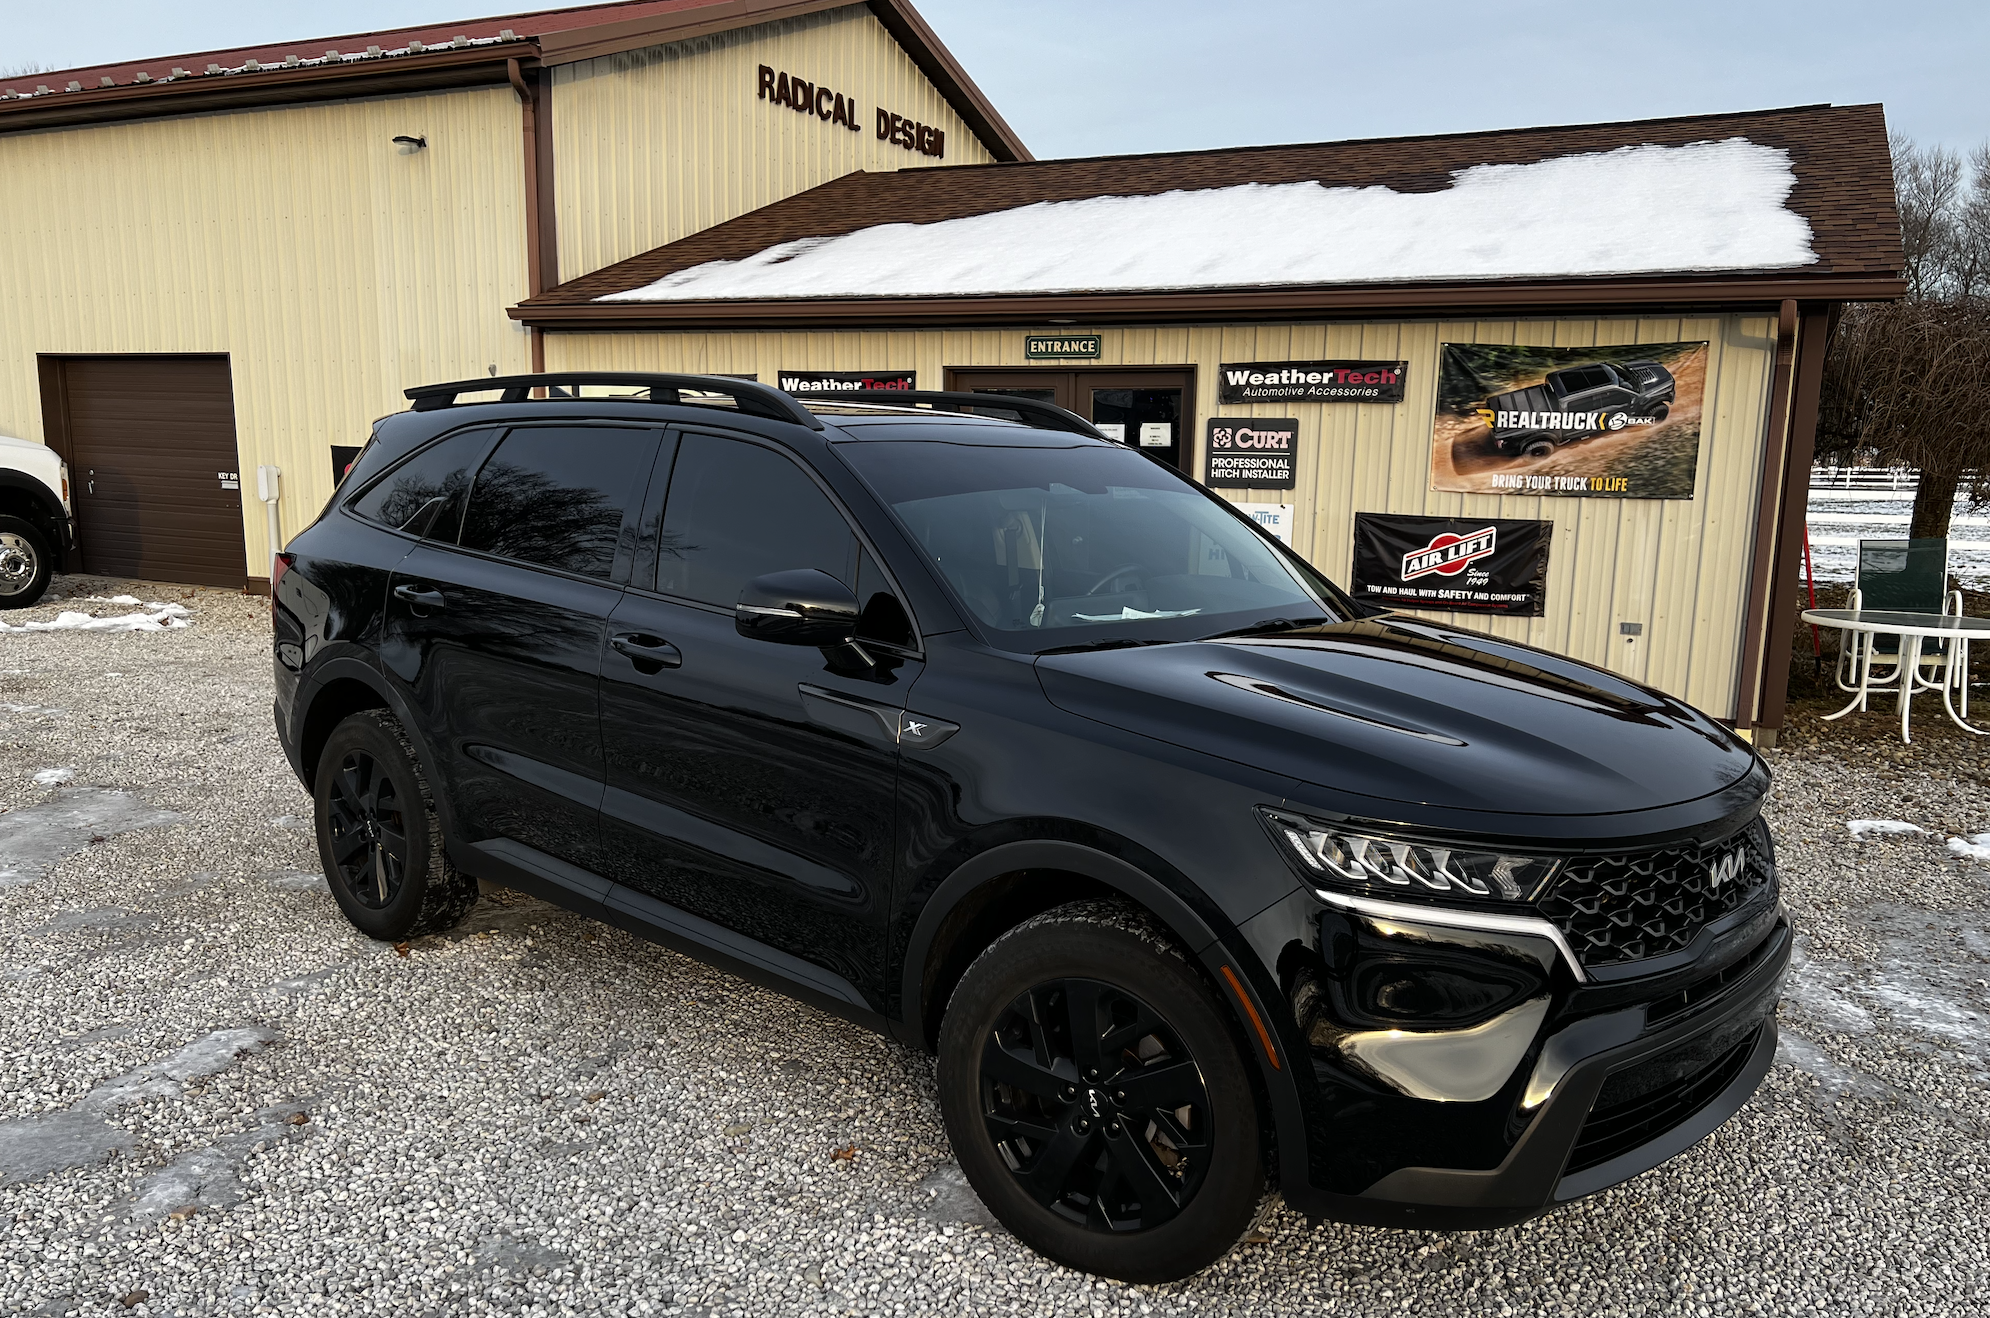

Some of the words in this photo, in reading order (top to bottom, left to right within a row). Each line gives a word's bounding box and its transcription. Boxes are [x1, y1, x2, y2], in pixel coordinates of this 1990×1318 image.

[758, 63, 861, 132] RADICAL
[876, 106, 945, 159] DESIGN
[1030, 340, 1096, 353] ENTRANCE
[1242, 386, 1304, 397] Automotive
[1307, 386, 1379, 397] Accessories
[1497, 410, 1599, 430] REALTRUCK
[1235, 427, 1292, 449] CURT
[1211, 457, 1290, 469] PROFESSIONAL
[217, 472, 229, 480] KEY
[1211, 468, 1240, 479] HITCH
[1242, 469, 1290, 480] INSTALLER
[1491, 474, 1523, 489] BRING
[1525, 475, 1551, 490] YOUR
[1554, 476, 1588, 491] TRUCK
[1590, 477, 1603, 491] TO
[1605, 477, 1628, 492] LIFE
[1407, 552, 1444, 573] AIR
[1447, 535, 1491, 559] LIFT
[1466, 568, 1490, 578] Since
[1466, 577, 1489, 586] 1949
[1366, 584, 1381, 593] TOW
[1382, 586, 1397, 594] AND
[1398, 587, 1417, 596] HAUL
[1418, 588, 1437, 598] WITH
[1437, 589, 1473, 600] SAFETY
[1473, 592, 1489, 601] AND
[1490, 593, 1527, 602] COMFORT
